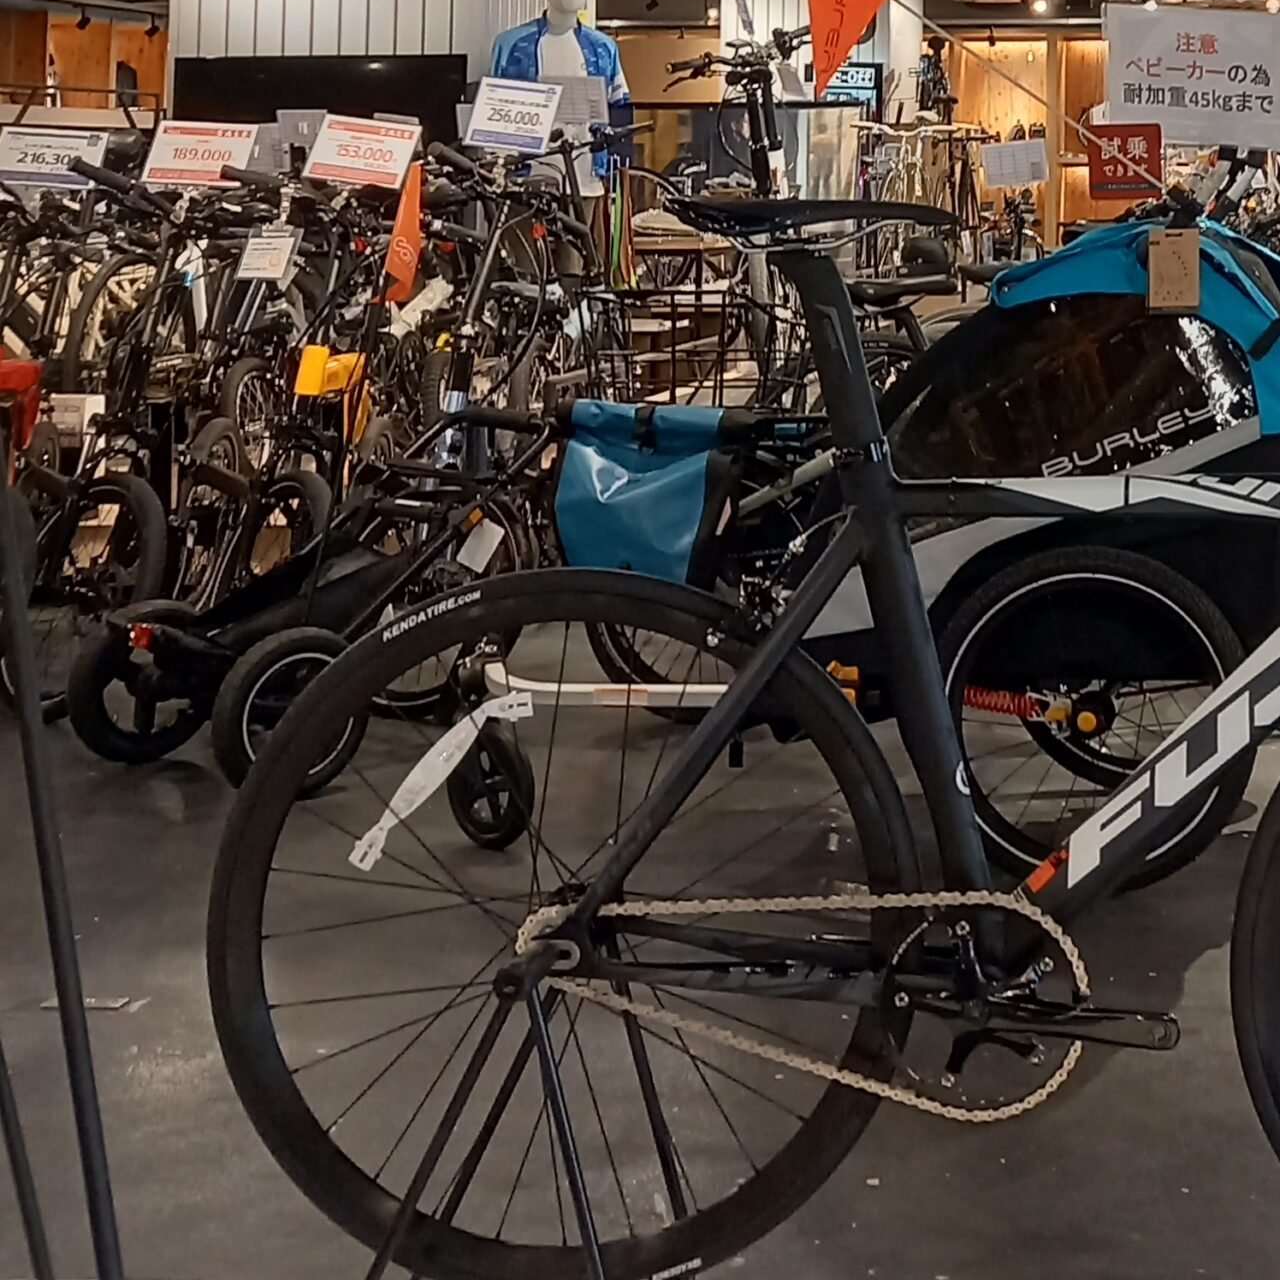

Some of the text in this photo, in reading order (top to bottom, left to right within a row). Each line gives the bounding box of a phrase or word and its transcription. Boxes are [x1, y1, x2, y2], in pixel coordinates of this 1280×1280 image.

[1175, 32, 1219, 55] 注意
[1122, 81, 1274, 114] 耐加重45kgまで
[16, 150, 83, 167] 216,30
[1040, 401, 1217, 478] BURLEY
